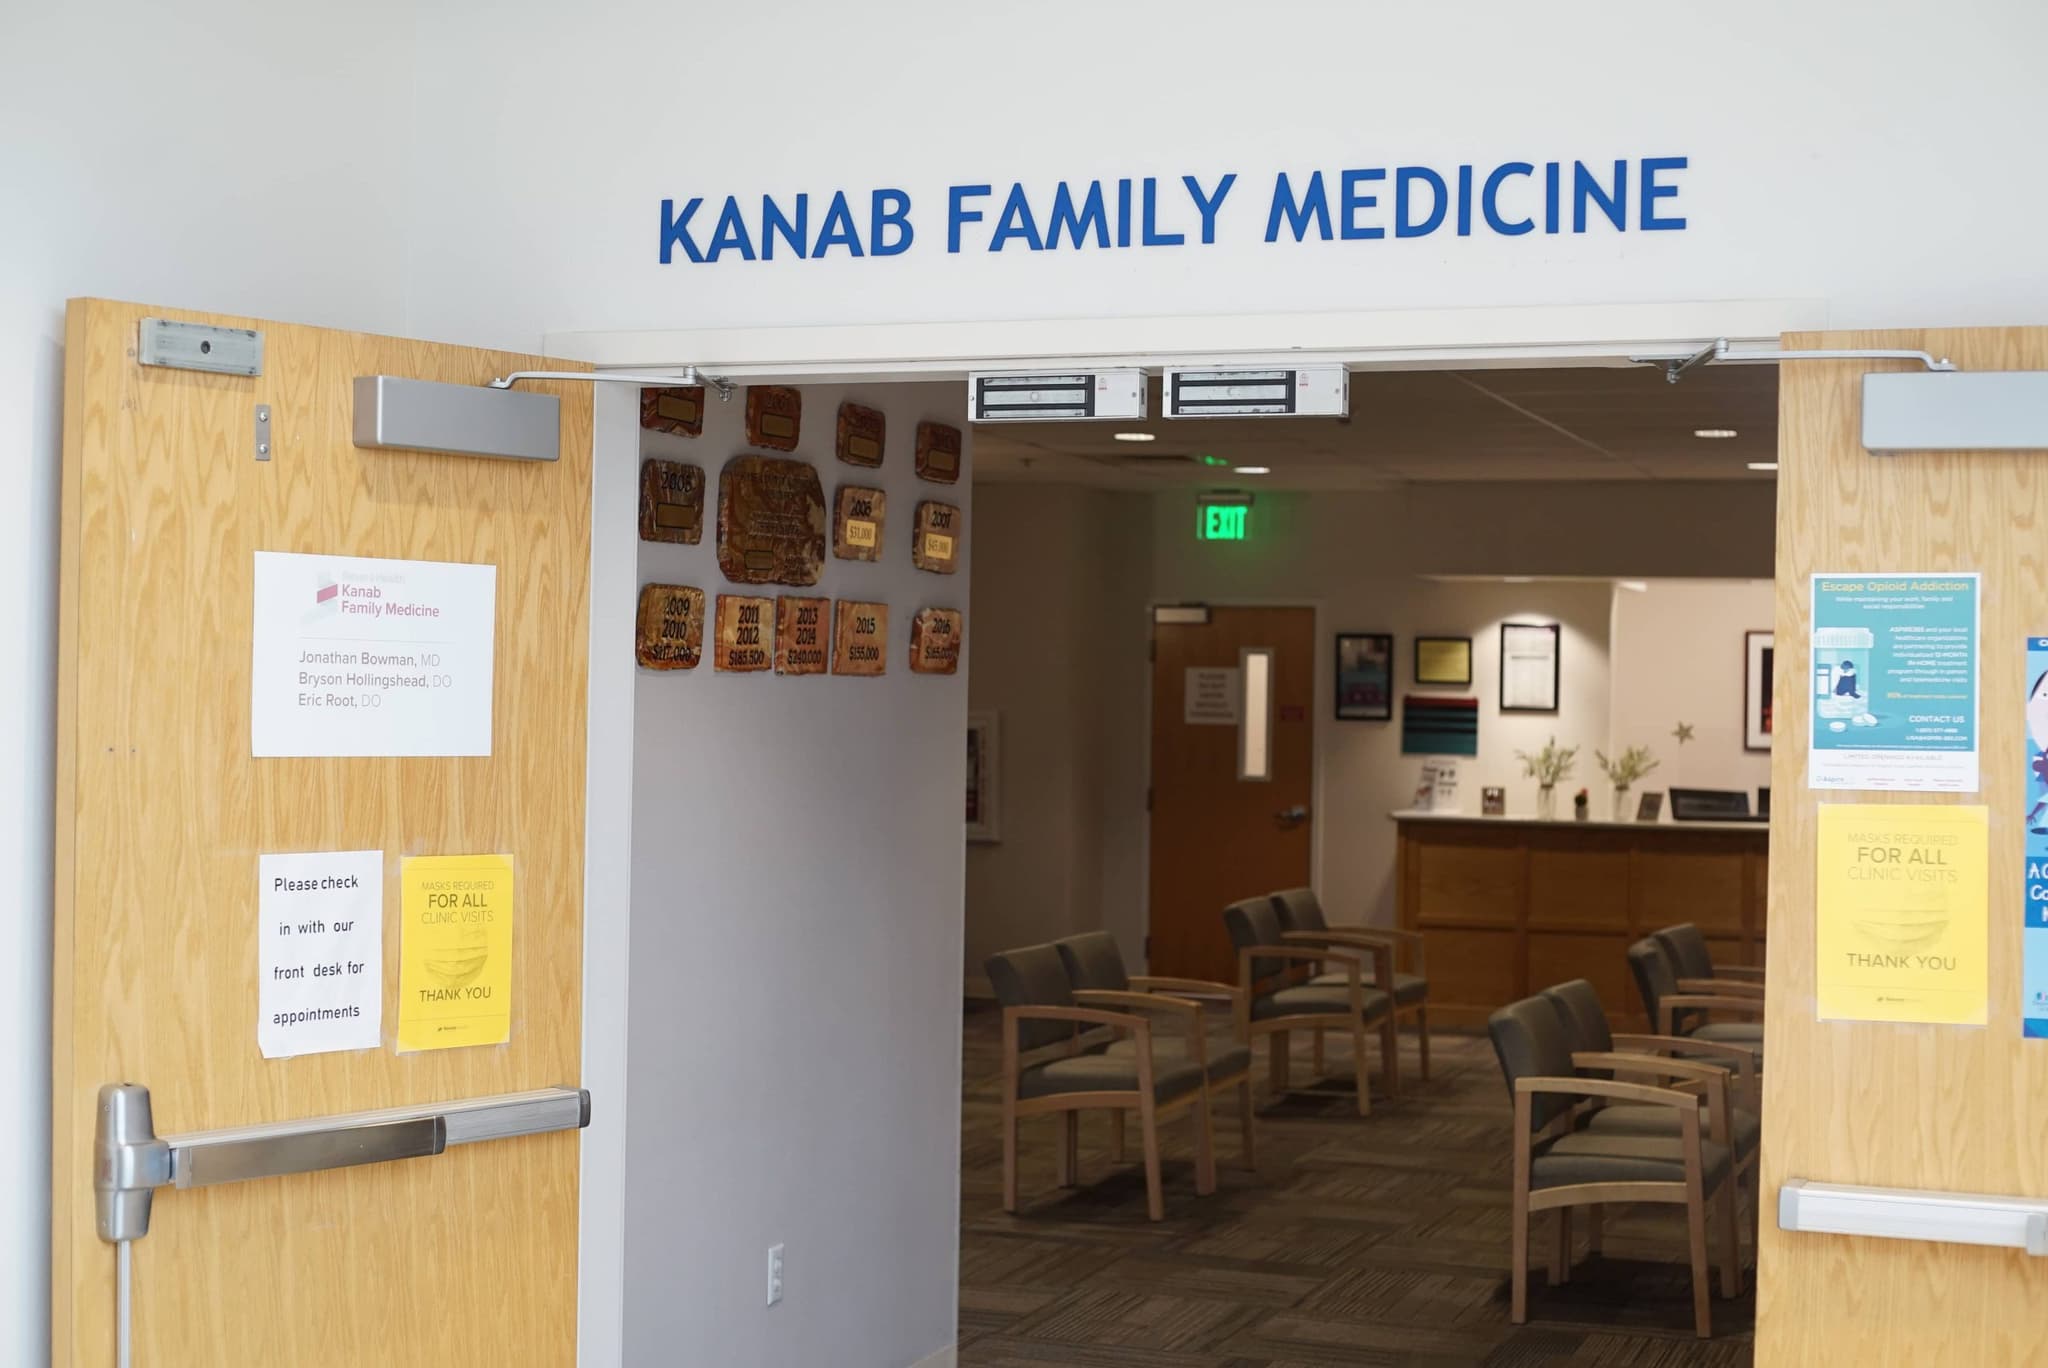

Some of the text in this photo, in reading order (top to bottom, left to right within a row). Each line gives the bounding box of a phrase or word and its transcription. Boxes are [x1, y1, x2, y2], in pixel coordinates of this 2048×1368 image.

[659, 157, 1688, 264] KANAB FAMILY MEDICINE
[932, 510, 952, 528] 2007
[1206, 505, 1248, 539] EXIT
[342, 584, 381, 598] Kanab
[1821, 581, 1969, 592] Escape Opioid Addiction
[341, 601, 439, 617] Family Medicine
[738, 605, 760, 624] 2011
[797, 607, 818, 625] 2013
[662, 618, 687, 639] 2010
[856, 616, 876, 634] 2015
[736, 626, 759, 645] 2012
[298, 651, 440, 668] Jonathan Bowman, MD
[298, 672, 452, 690] Bryson Hollingshead, DO
[298, 693, 381, 708] Eric Root, DO
[1908, 715, 1965, 723] CONTACT US
[1847, 833, 1959, 846] MASKS REQUIRED
[1857, 847, 1948, 865] FOR ALL
[1847, 866, 1958, 883] CLINIC VISITS
[274, 875, 359, 892] Please check
[422, 880, 494, 891] MASKS REQUIRED
[428, 893, 488, 908] FOR ALL
[421, 911, 494, 924] CLINIC VISITS
[279, 919, 354, 935] in with our
[274, 961, 365, 980] front desk for
[1847, 953, 1957, 971] THANK YOU
[419, 986, 492, 1002] THANK YOU
[273, 1005, 360, 1027] appointments
